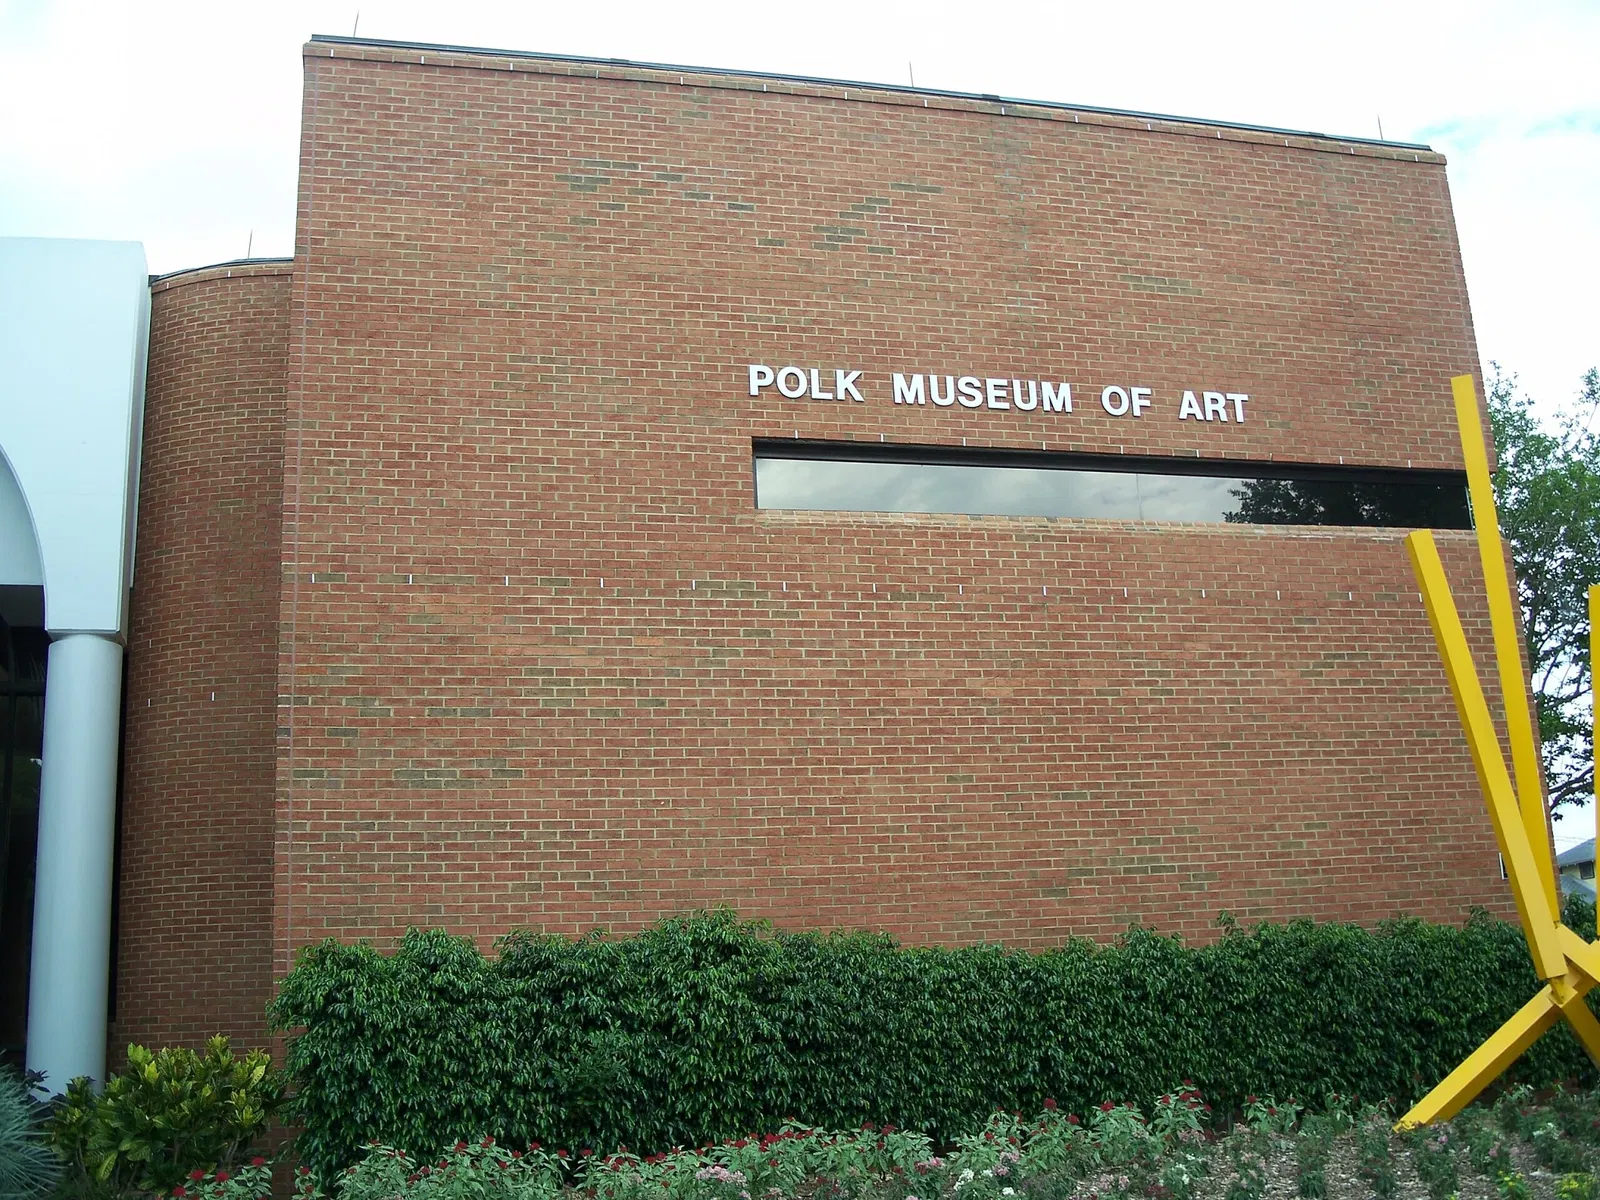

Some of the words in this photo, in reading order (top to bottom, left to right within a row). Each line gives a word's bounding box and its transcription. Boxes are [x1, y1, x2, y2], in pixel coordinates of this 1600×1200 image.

[746, 364, 866, 404] POLK
[892, 372, 1074, 413] MUSEUM
[1101, 385, 1152, 418] OF
[1178, 390, 1250, 424] ART
